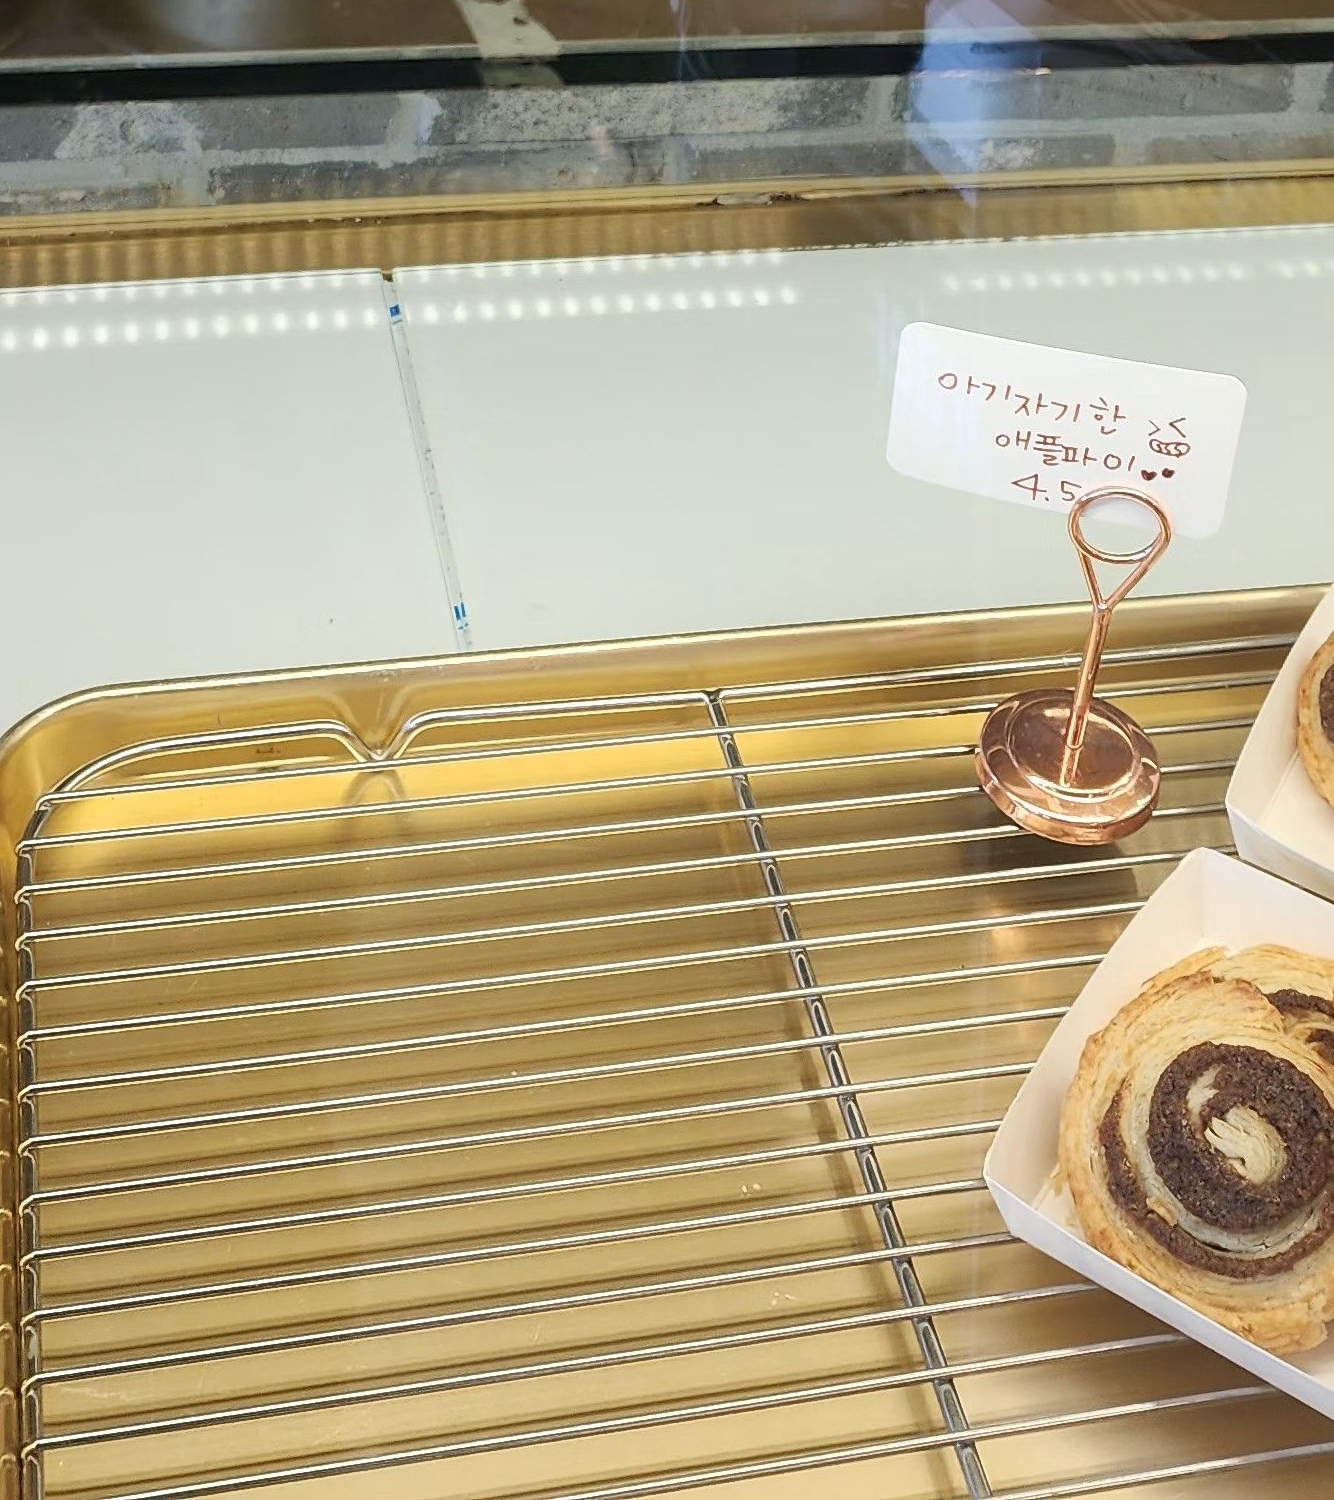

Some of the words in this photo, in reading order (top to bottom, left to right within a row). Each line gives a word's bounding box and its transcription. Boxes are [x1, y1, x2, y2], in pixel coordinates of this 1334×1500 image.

[937, 371, 1127, 436] 아기자기한
[994, 429, 1137, 473] 애플파이
[1010, 472, 1084, 503] 4.5
